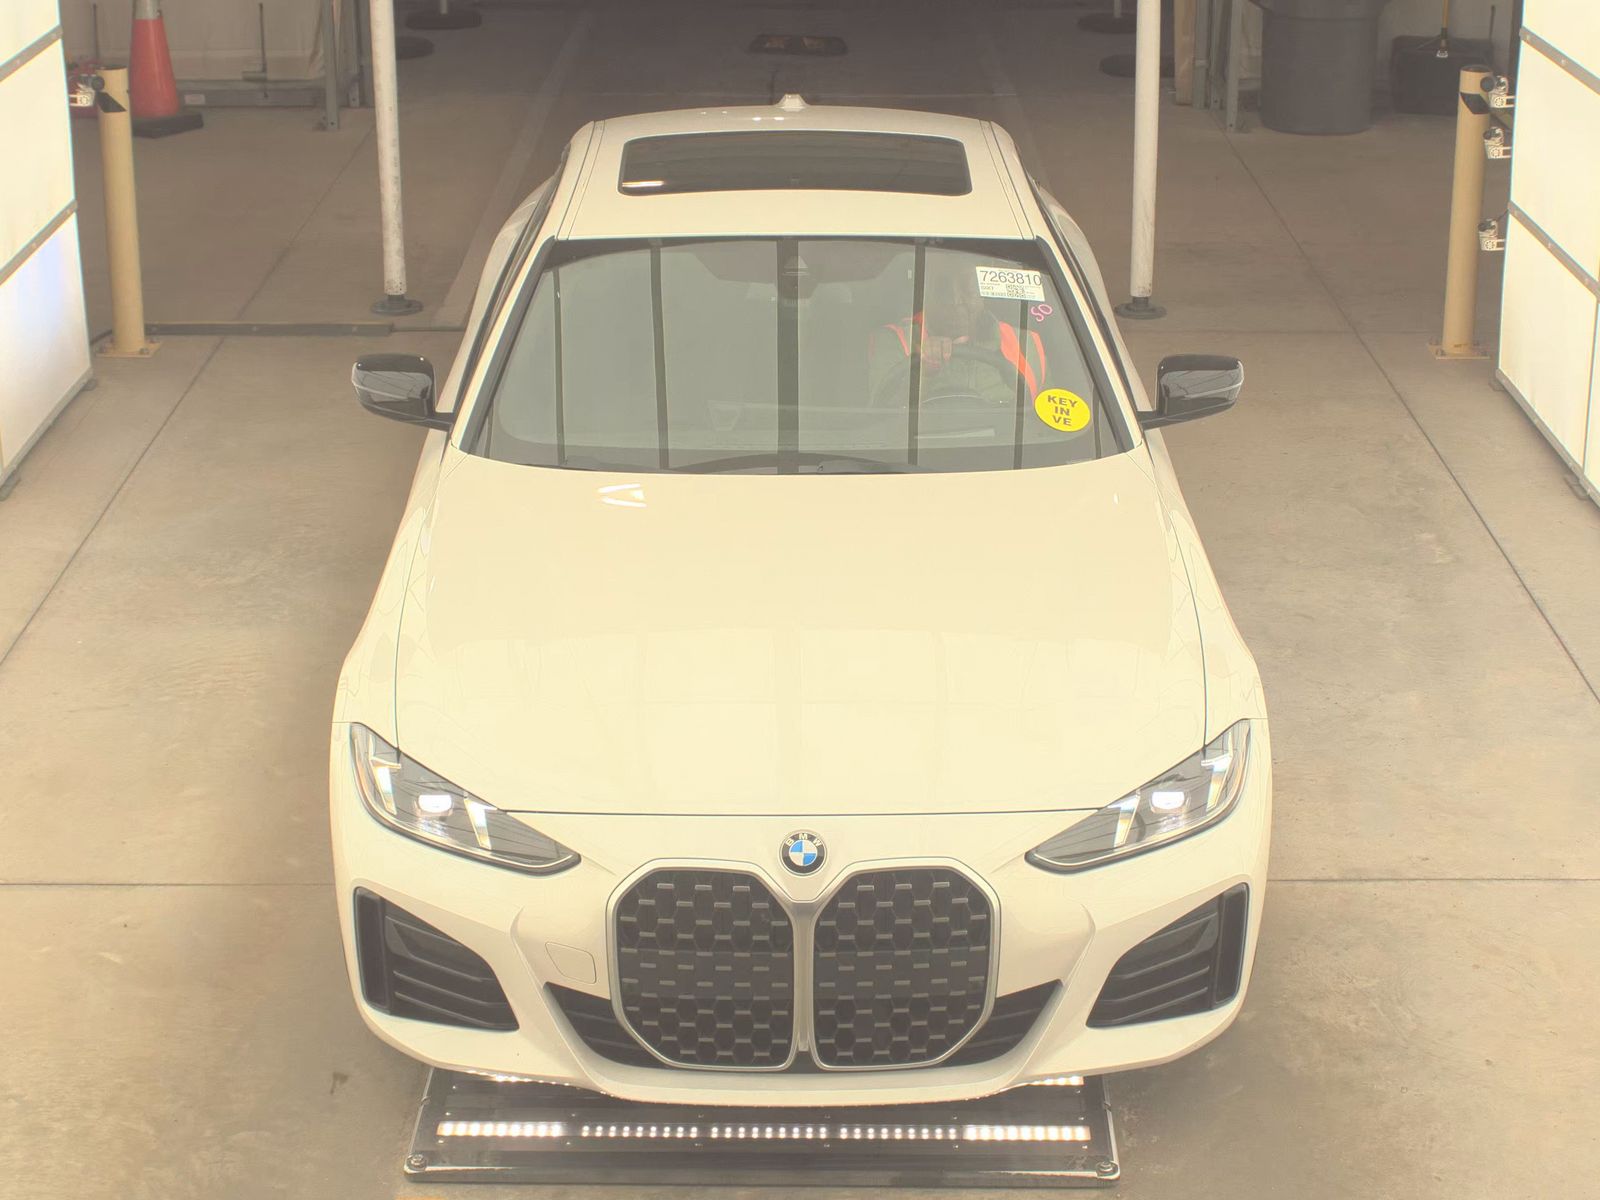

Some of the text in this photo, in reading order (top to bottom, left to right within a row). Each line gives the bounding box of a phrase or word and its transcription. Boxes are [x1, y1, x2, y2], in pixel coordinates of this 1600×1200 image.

[980, 270, 1041, 286] 7263810
[1047, 395, 1077, 408] KEY
[1054, 406, 1070, 416] IN
[1052, 415, 1072, 426] VE
[785, 833, 822, 847] BMW
